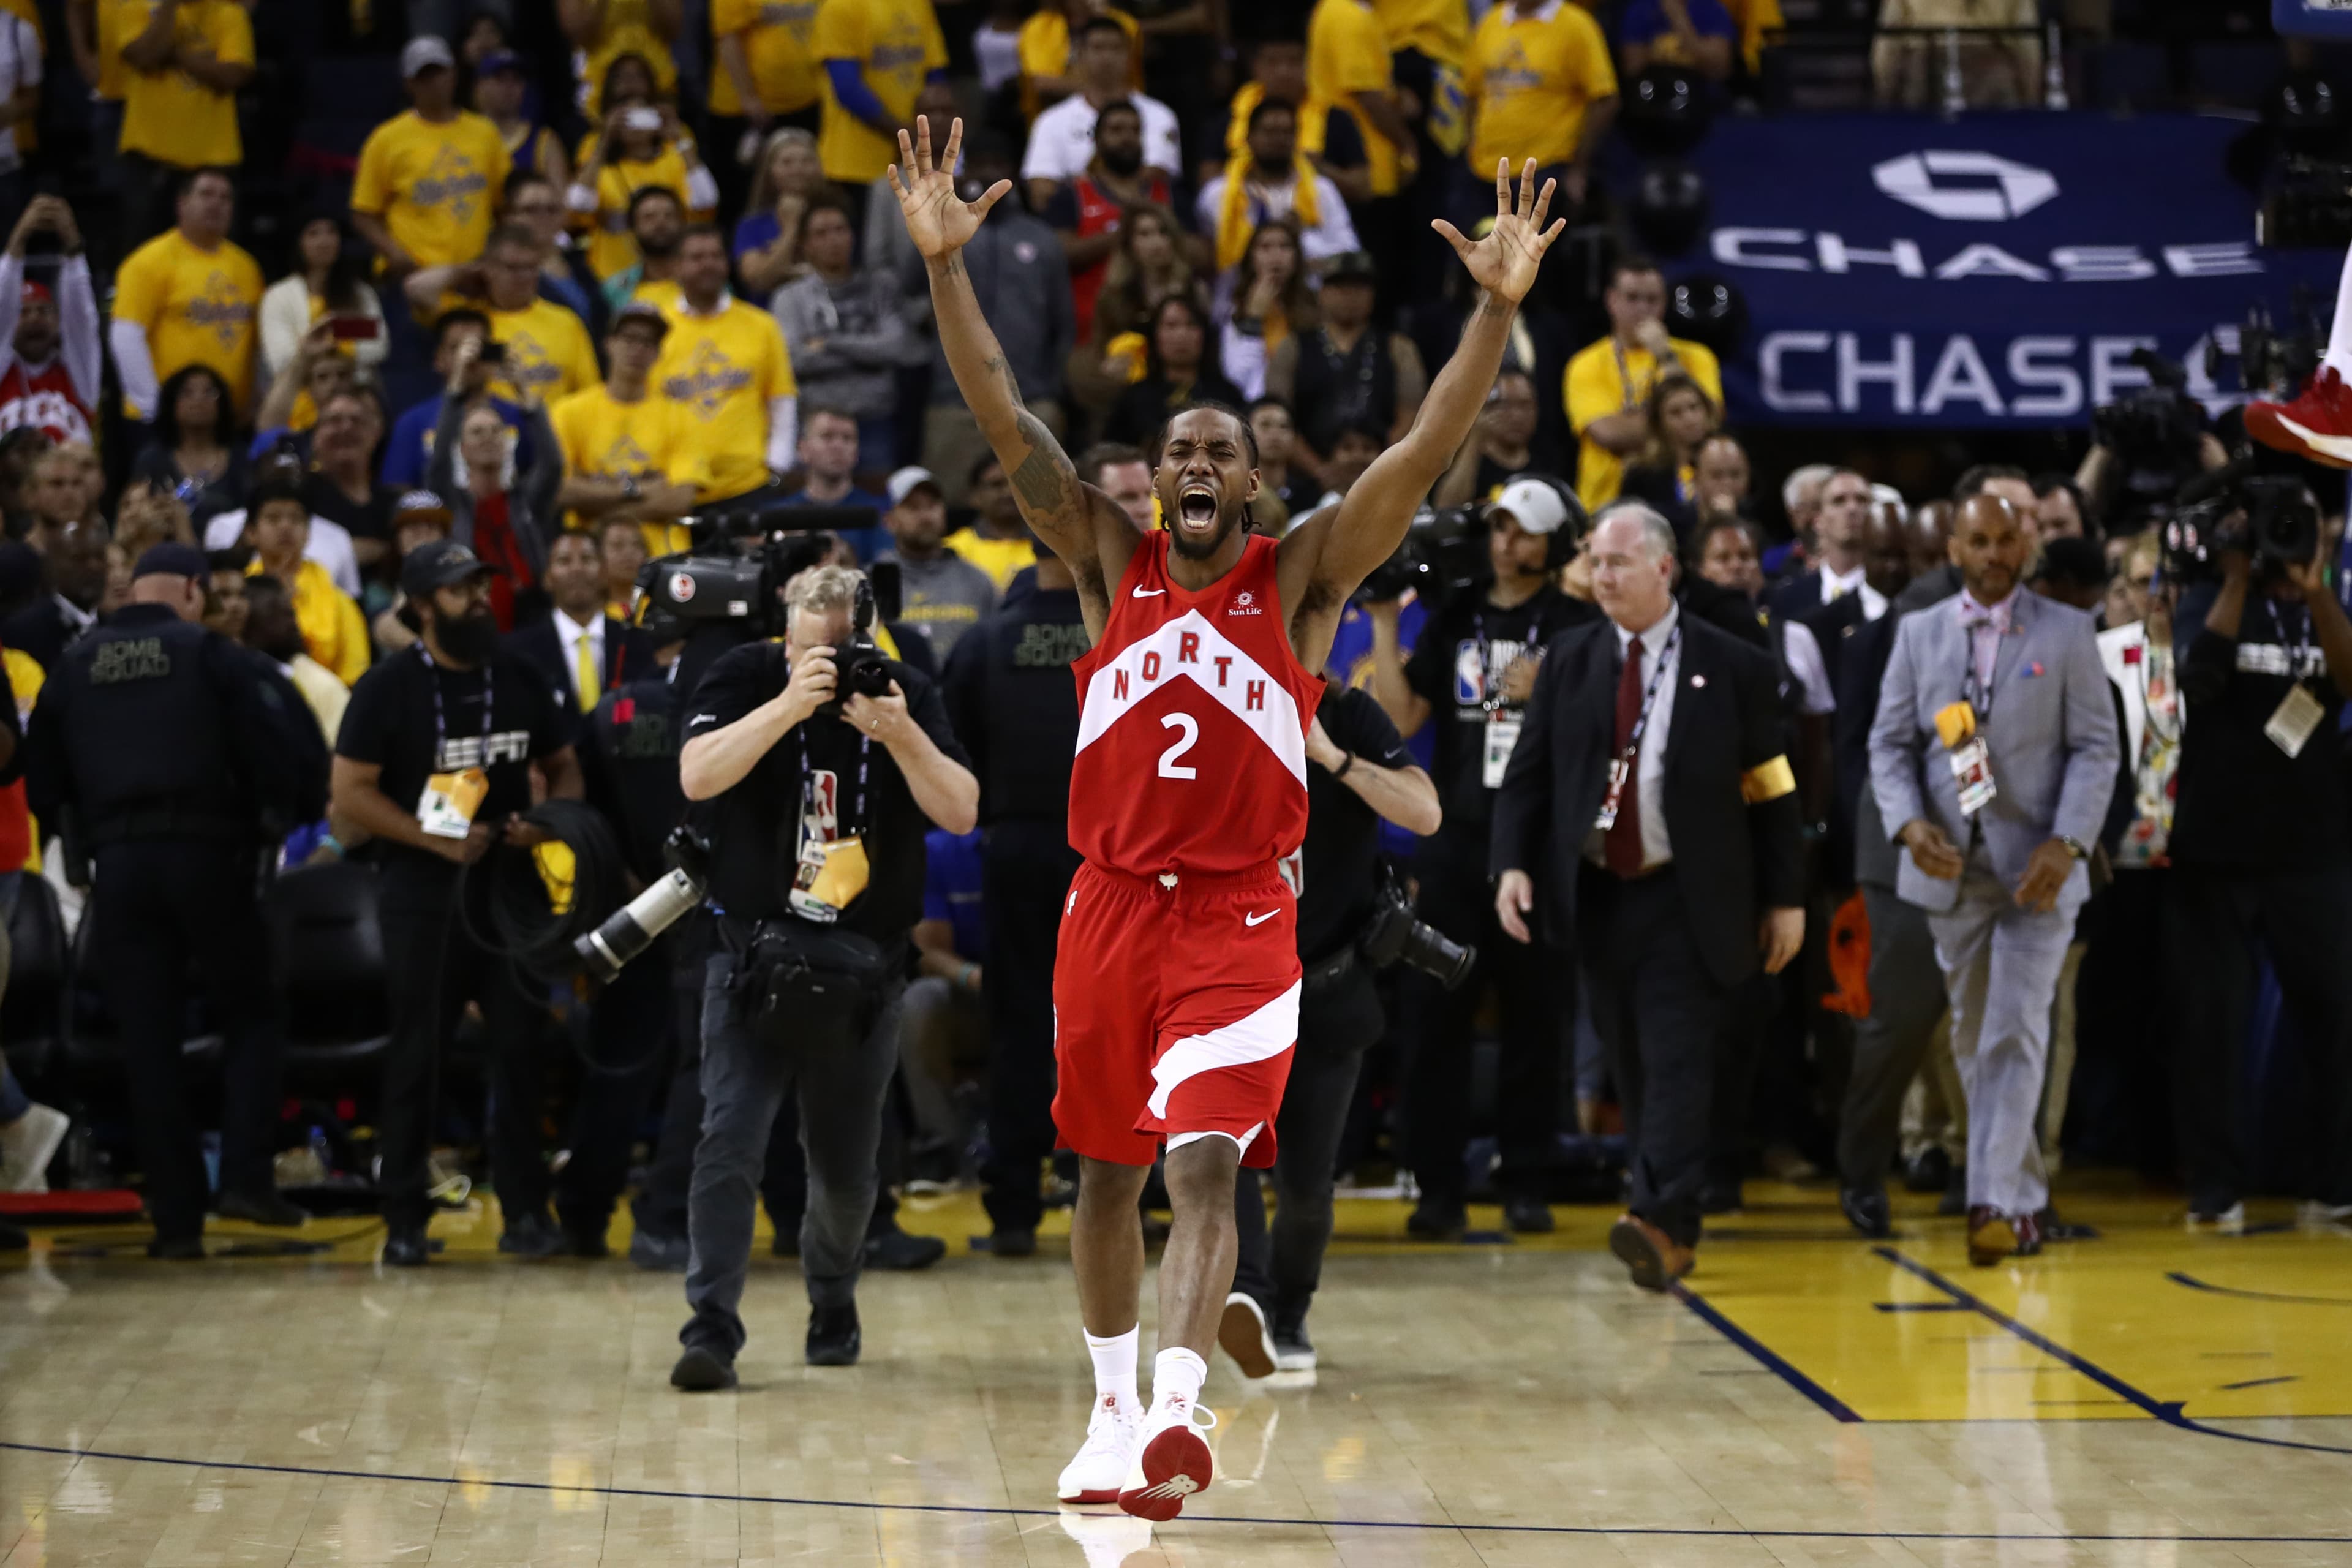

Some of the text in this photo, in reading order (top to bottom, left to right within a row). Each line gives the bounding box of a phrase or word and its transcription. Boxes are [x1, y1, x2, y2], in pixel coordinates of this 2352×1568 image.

[1710, 226, 2266, 282] CHASE
[1246, 607, 1262, 616] Life
[89, 654, 172, 685] SQUAD
[97, 637, 162, 661] BOMB
[1112, 630, 1266, 712] NORTH
[1158, 712, 1199, 780] 2
